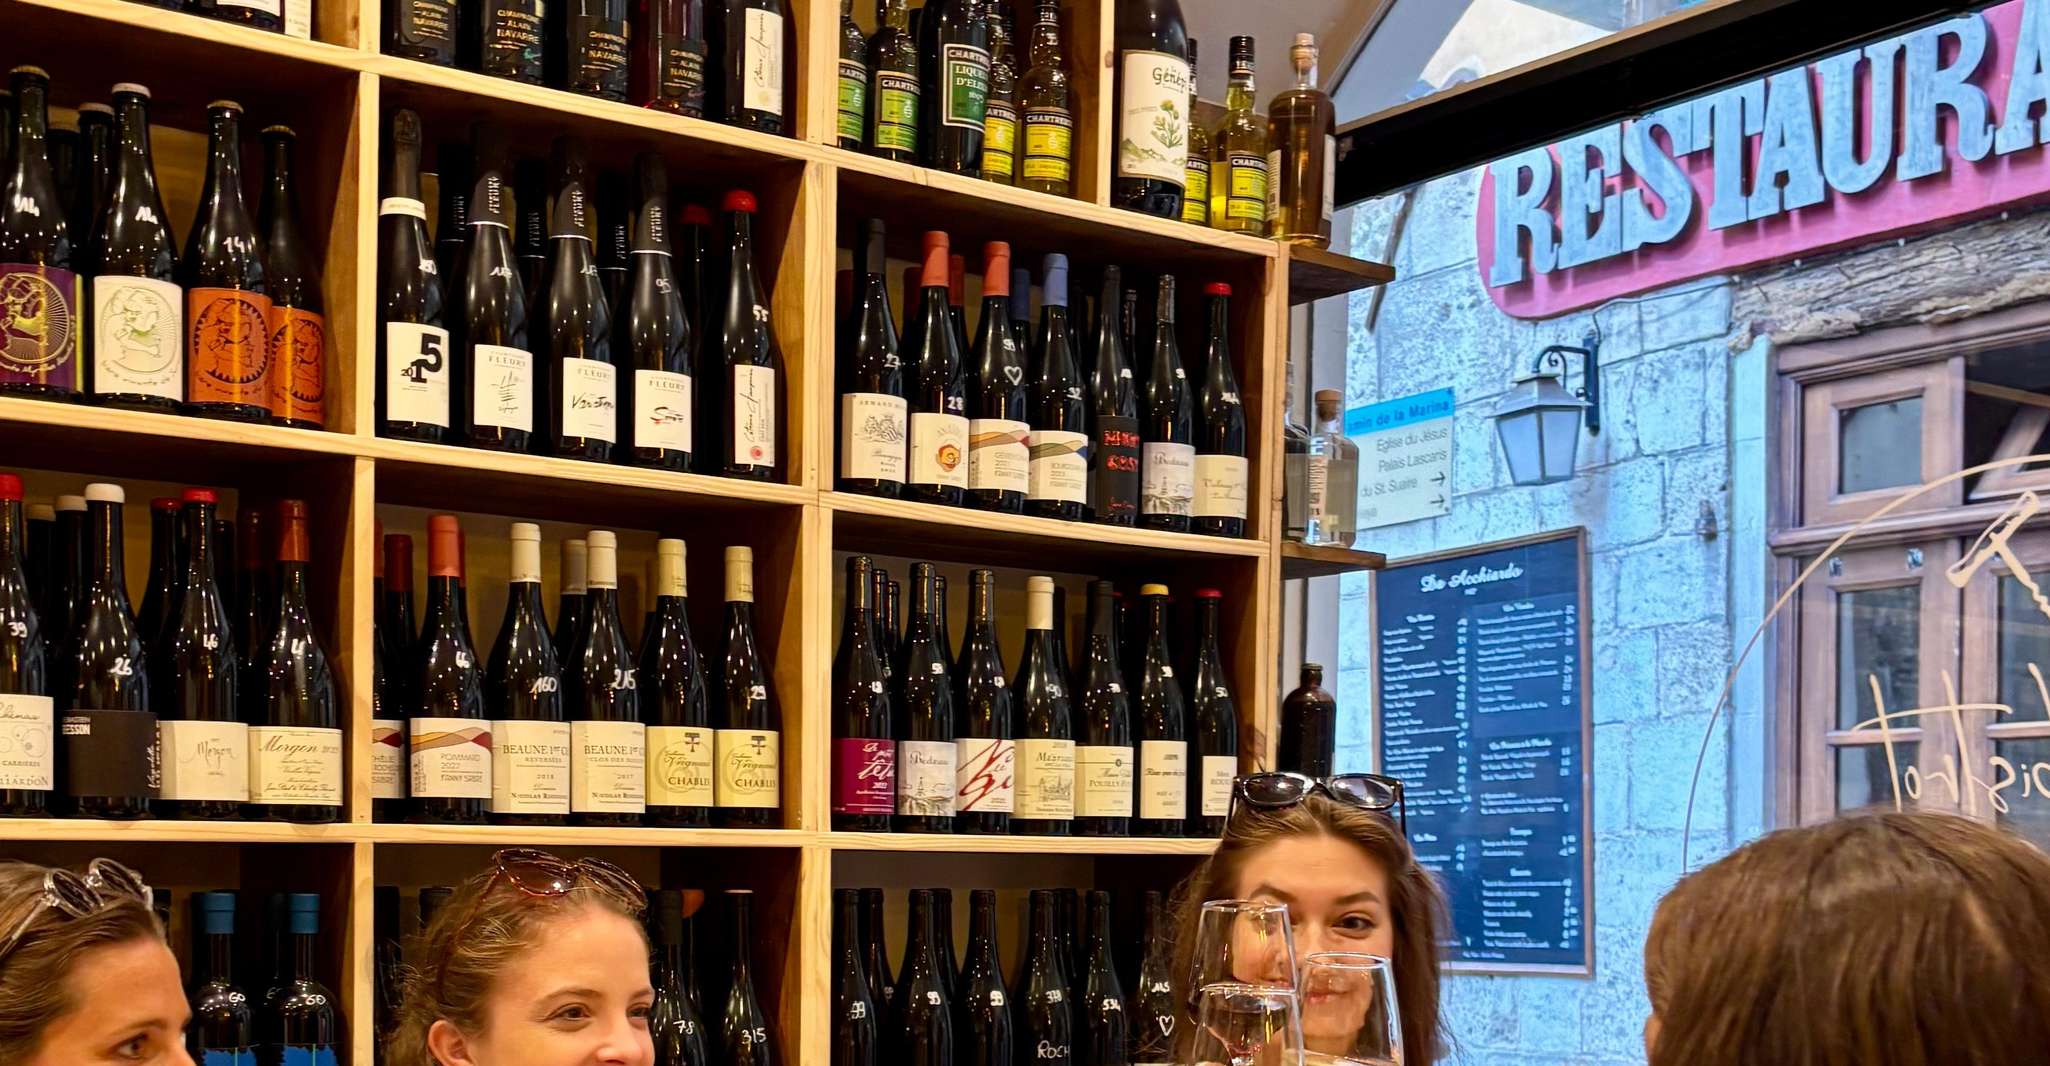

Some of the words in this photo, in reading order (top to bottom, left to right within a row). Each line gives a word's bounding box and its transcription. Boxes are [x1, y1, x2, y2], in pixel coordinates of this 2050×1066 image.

[222, 235, 246, 254] 14
[1376, 412, 1391, 426] de
[1394, 407, 1405, 421] la
[1409, 400, 1450, 418] Marina
[1405, 433, 1418, 446] du
[1378, 457, 1405, 473] Palais
[1407, 449, 1448, 468] Lascaris
[1388, 474, 1418, 493] Suaire
[258, 735, 318, 757] Morgon
[503, 744, 550, 755] BEAUNE
[584, 745, 630, 756] BEAUNE
[1037, 1039, 1071, 1059] ROCH
